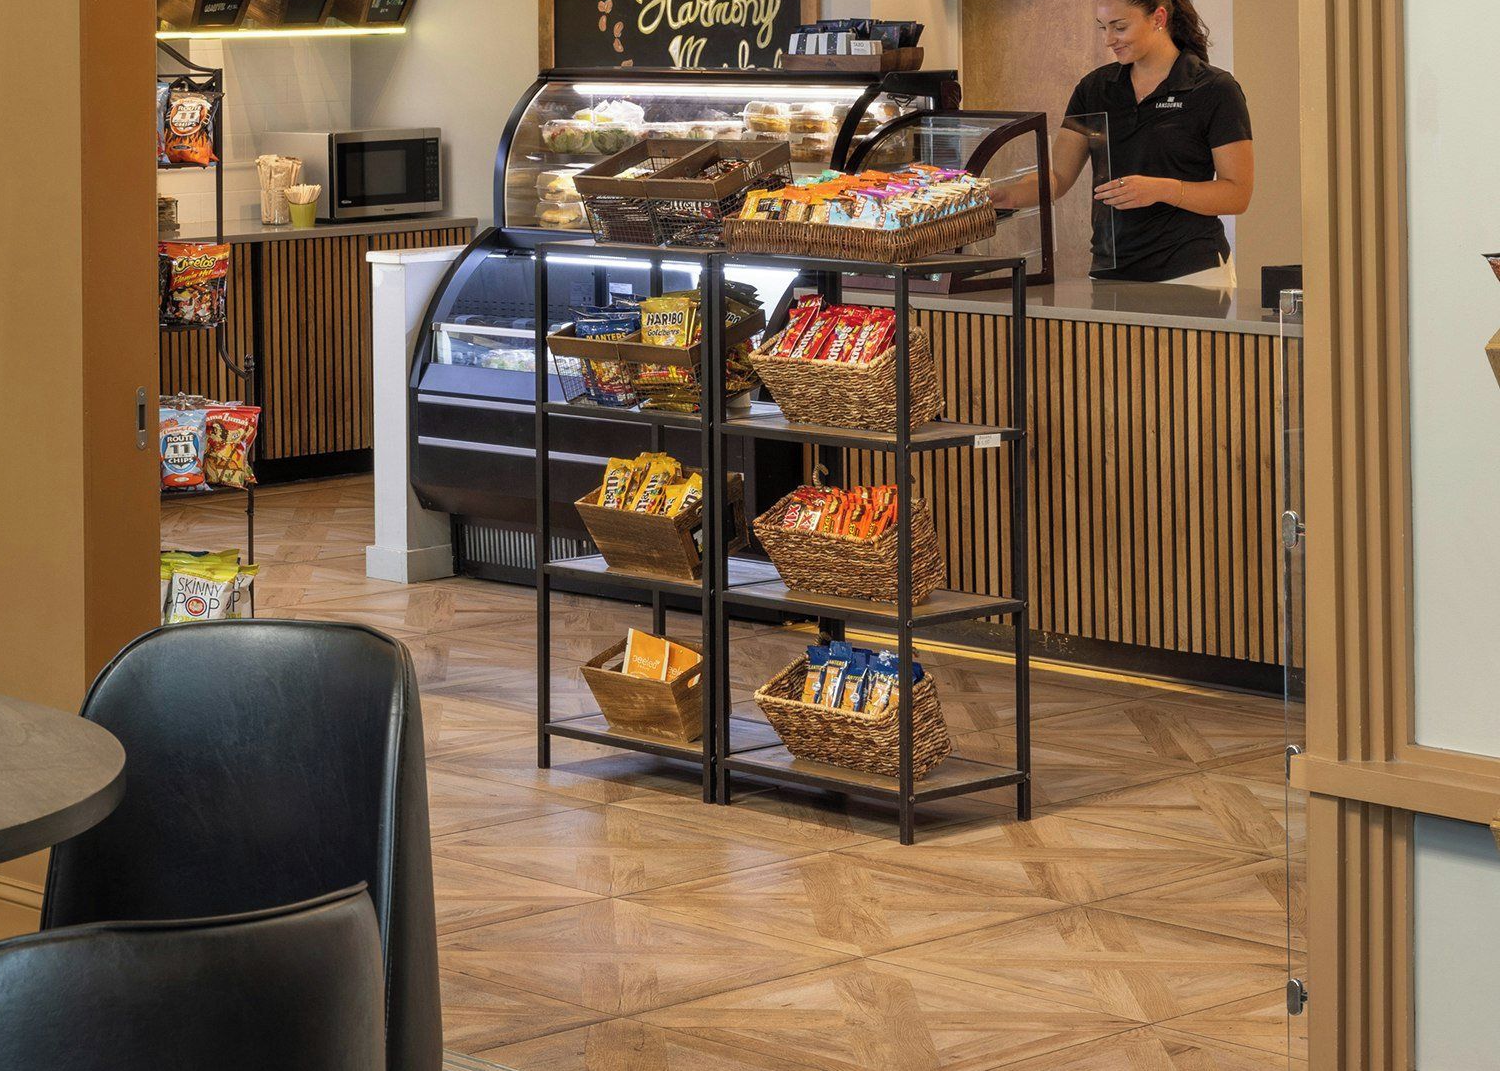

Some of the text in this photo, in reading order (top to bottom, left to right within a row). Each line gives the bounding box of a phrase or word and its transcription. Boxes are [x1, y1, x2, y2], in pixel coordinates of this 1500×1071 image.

[175, 255, 217, 272] Cheetos
[646, 311, 684, 326] HARIBO
[167, 434, 193, 443] ROUTE
[169, 443, 191, 454] 11
[177, 577, 223, 597] SKINNY
[174, 592, 220, 619] POP
